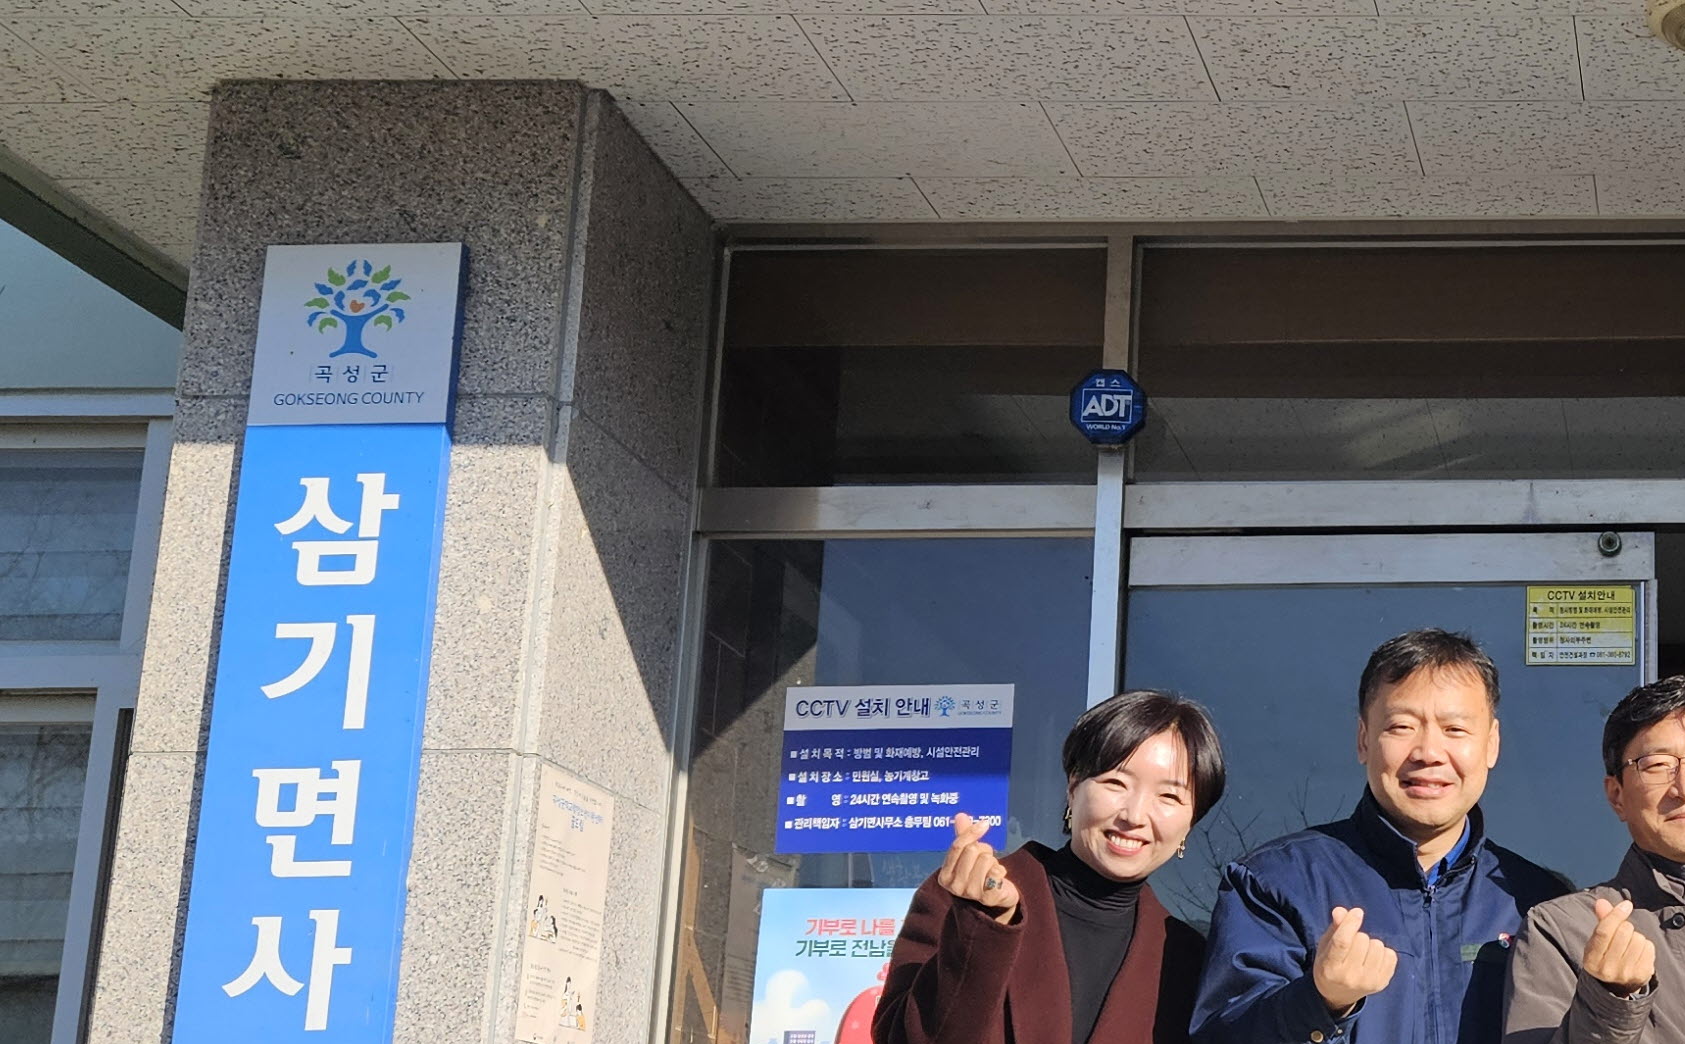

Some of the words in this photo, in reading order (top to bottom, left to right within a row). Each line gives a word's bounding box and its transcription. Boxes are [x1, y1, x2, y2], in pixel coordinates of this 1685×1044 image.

[314, 364, 389, 383] 곡성군
[273, 392, 359, 406] GOKSEONG
[361, 391, 425, 405] COUNTY
[1082, 393, 1133, 418] ADT
[1547, 590, 1575, 600] CCTV
[796, 699, 851, 717] CCTV
[855, 697, 890, 719] 설치
[895, 697, 931, 718] 안내
[926, 745, 980, 759] 시설안전관리
[849, 793, 880, 806] 24시간
[849, 815, 903, 829] 삼기면사무소
[805, 918, 857, 937] 기부로
[861, 918, 896, 937] 나를
[795, 939, 847, 957] 기부로
